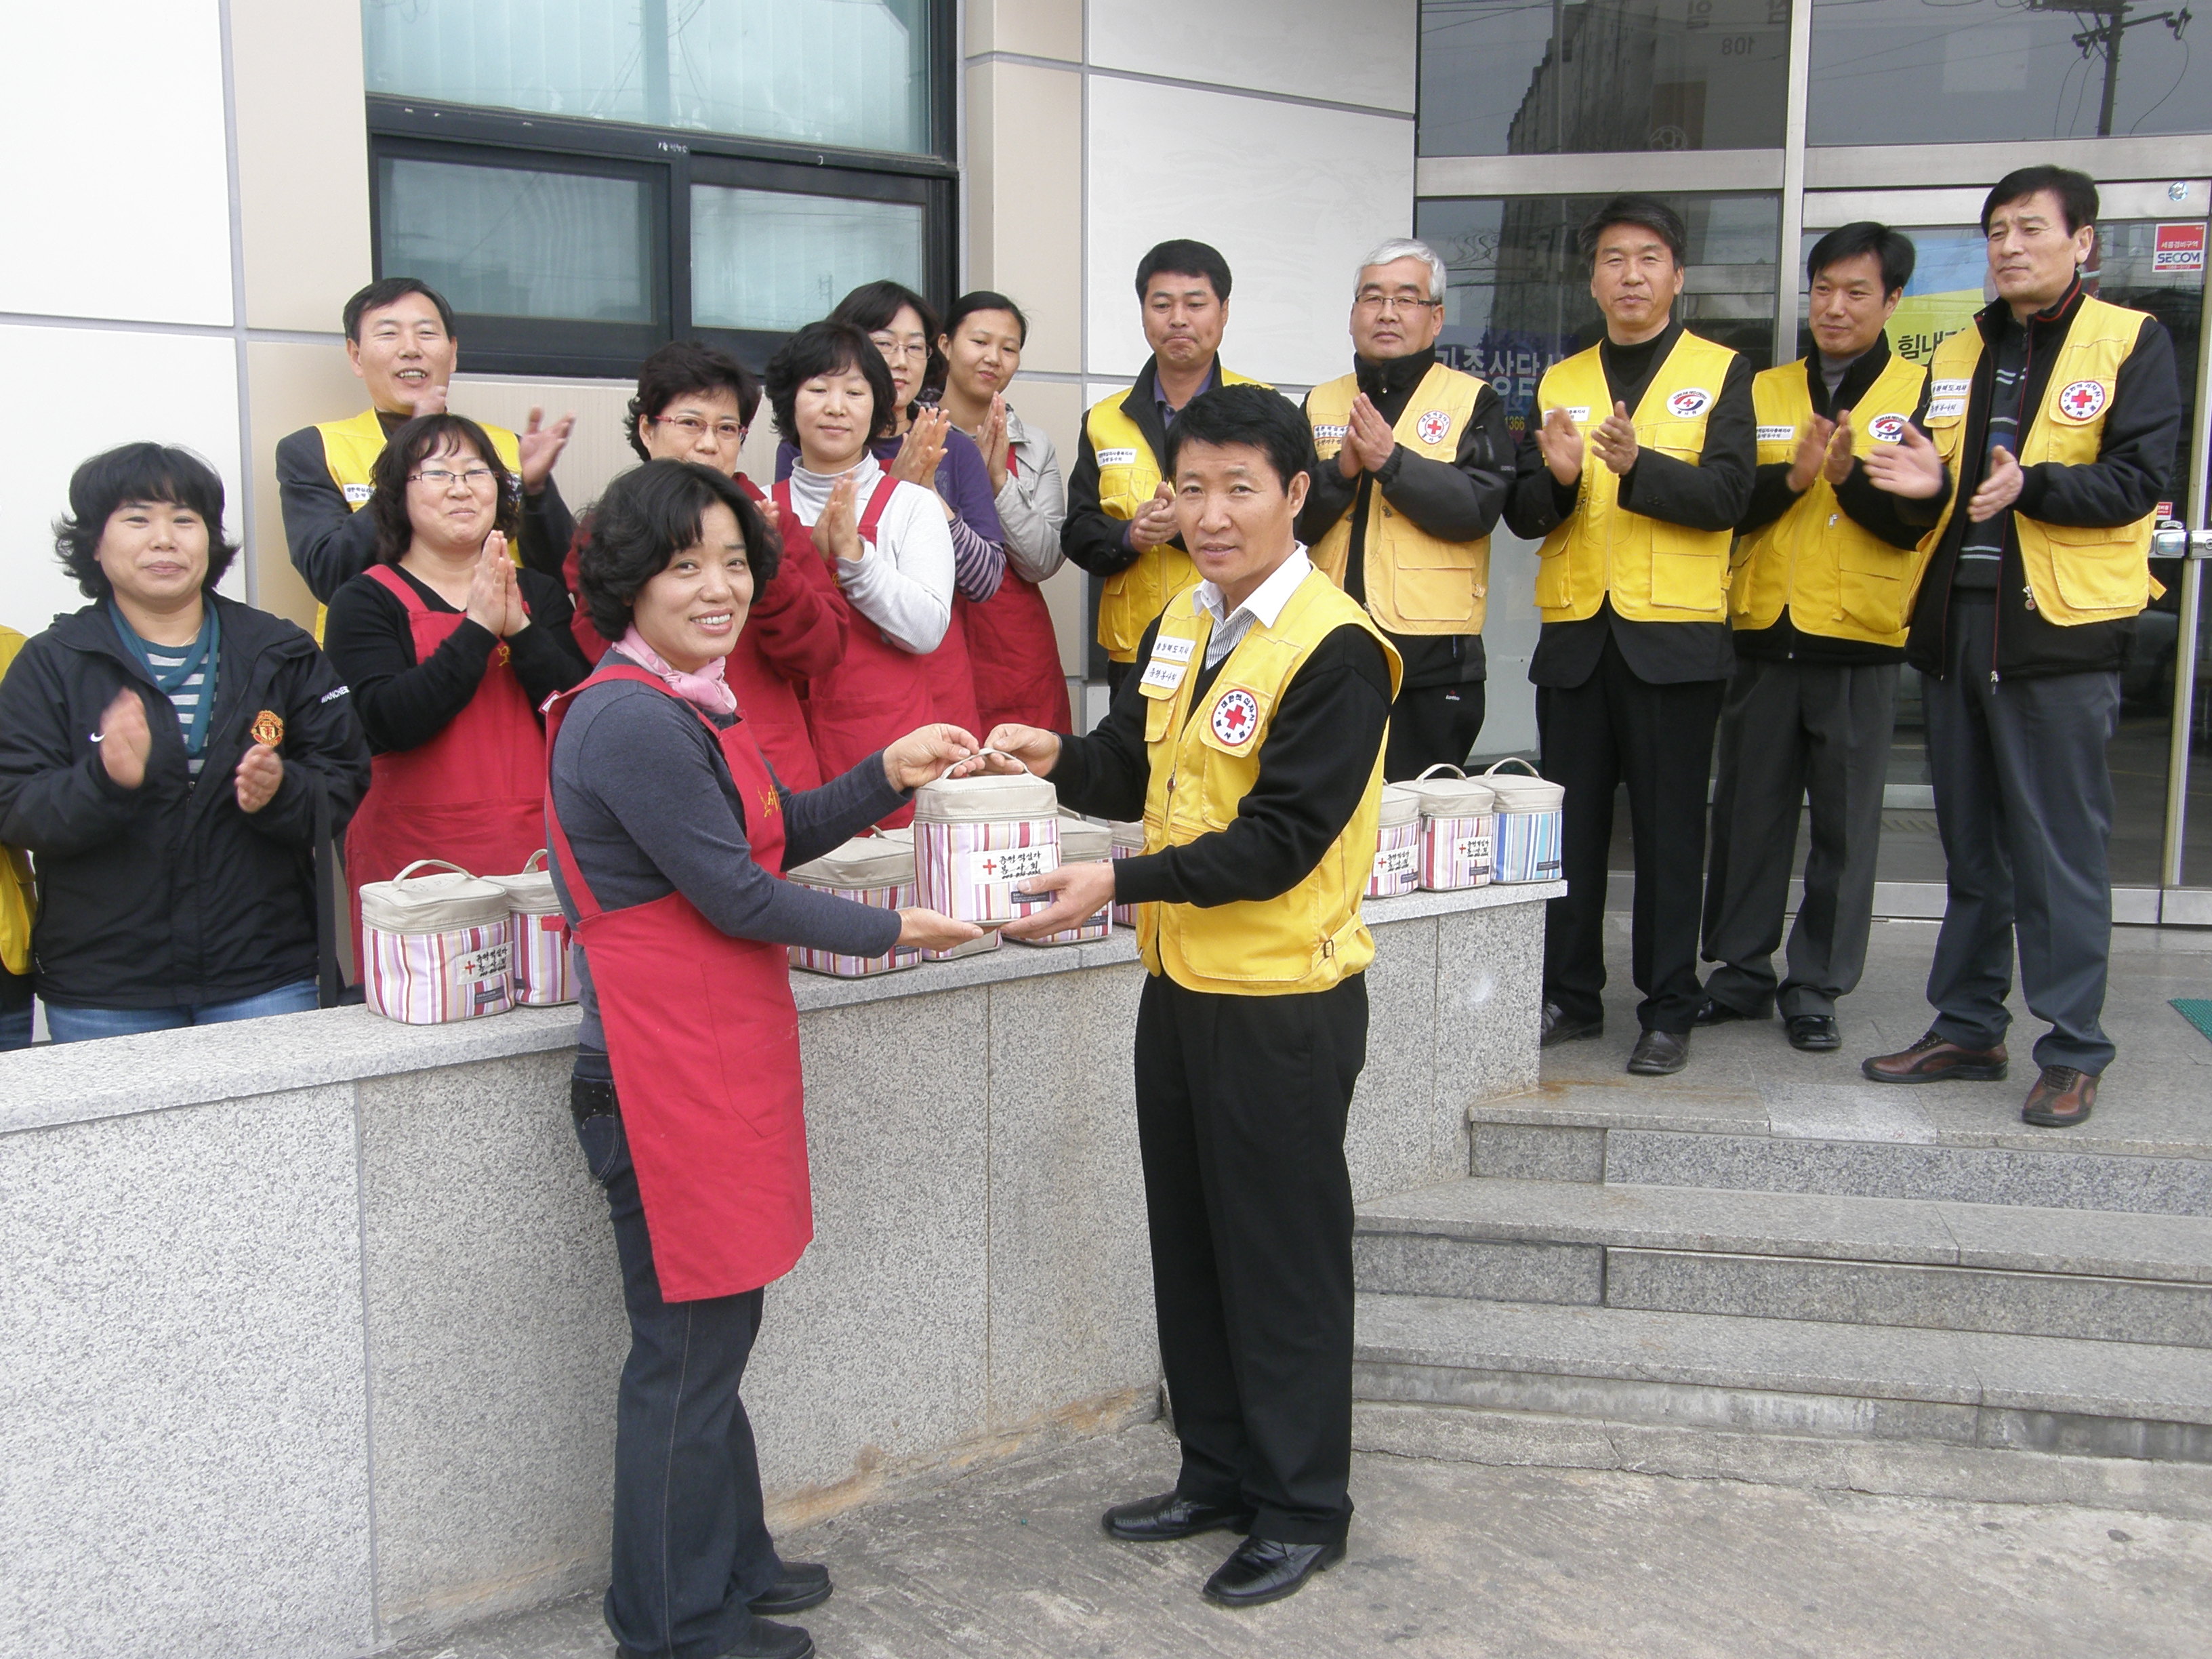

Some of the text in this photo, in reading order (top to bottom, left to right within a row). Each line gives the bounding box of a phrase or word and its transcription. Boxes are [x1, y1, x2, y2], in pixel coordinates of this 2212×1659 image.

[2158, 252, 2200, 264] SECOM
[1898, 328, 1966, 360] 힘내
[1505, 415, 1525, 431] 1366
[1221, 693, 1255, 722] 대한적십자사
